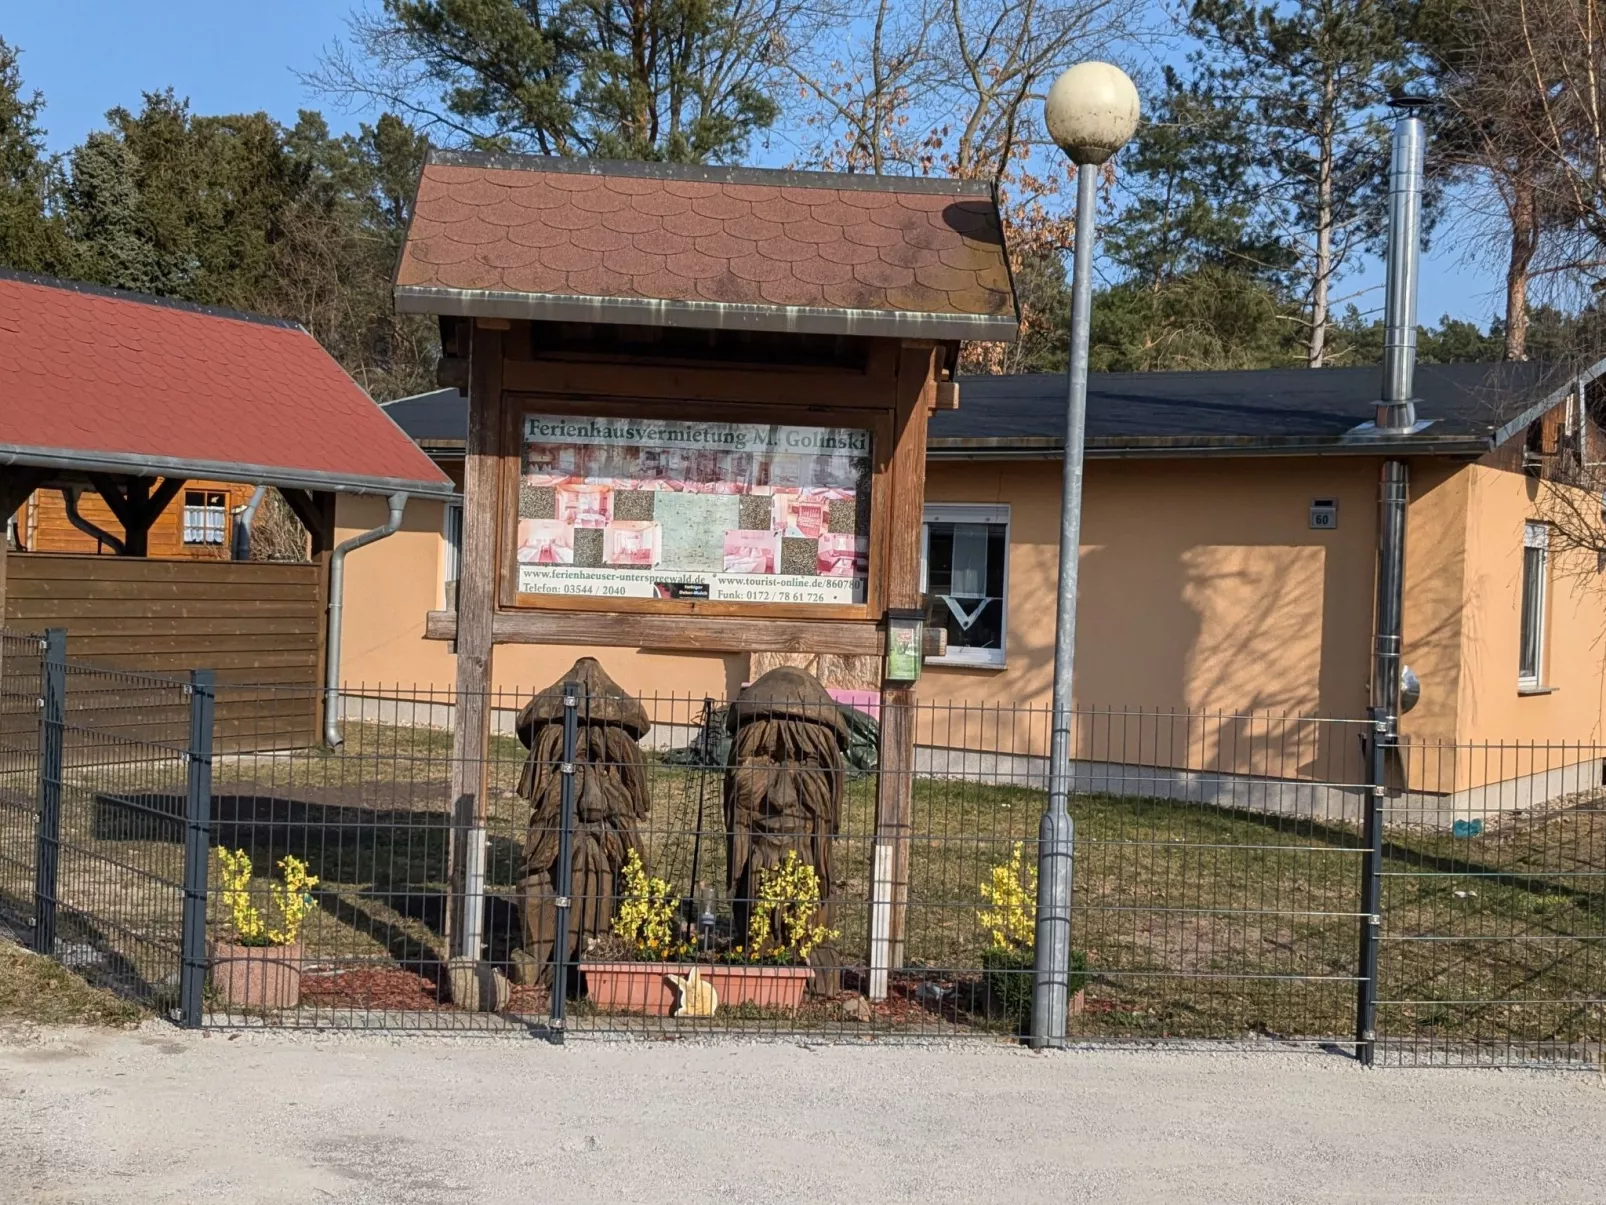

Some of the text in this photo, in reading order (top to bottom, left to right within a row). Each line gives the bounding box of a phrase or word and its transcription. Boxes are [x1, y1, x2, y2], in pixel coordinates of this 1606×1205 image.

[528, 418, 867, 450] Ferienhausvermietung M. Golinski
[1315, 514, 1329, 525] 60
[523, 569, 706, 585] www.ferienhaeuser-unterspreewald.de
[717, 576, 861, 590] www.tourist-online.de/860780
[523, 583, 561, 593] Telefon:
[563, 584, 593, 594] 03544
[602, 585, 626, 596] 2040
[717, 589, 744, 600] Funk:
[746, 590, 770, 601] 0172
[779, 591, 790, 601] 78
[792, 592, 804, 602] 61
[807, 592, 824, 602] 726
